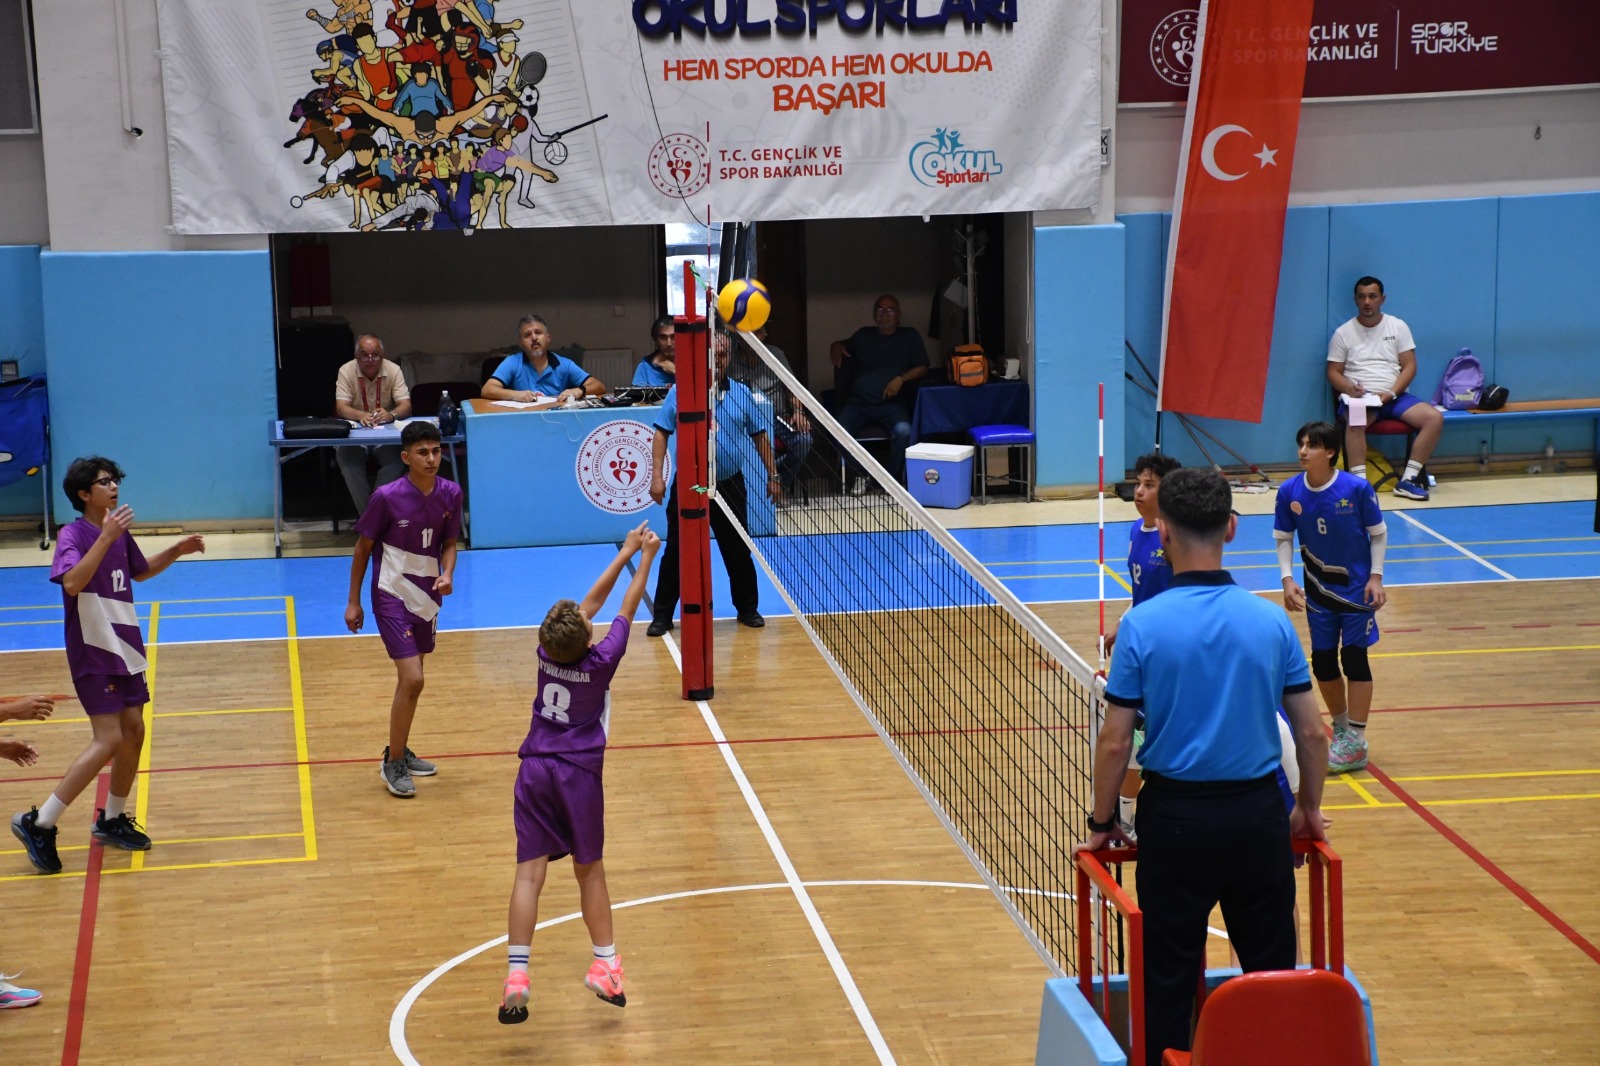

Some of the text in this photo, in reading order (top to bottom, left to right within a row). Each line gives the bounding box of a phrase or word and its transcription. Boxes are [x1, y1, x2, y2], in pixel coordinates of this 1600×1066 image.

[632, 0, 772, 37] OKUL
[1355, 23, 1379, 38] VE
[1411, 34, 1499, 55] TÜRKİYE
[663, 50, 994, 82] HEM SPORDA HEM OKULDA
[772, 81, 886, 116] BAŞARI
[719, 145, 842, 164] T.C. GENÇLİK VE
[921, 150, 1003, 178] OKUL
[719, 161, 843, 180] SPOR BAKANLIĞI
[936, 168, 990, 188] Sporları
[1316, 517, 1328, 535] 6
[421, 528, 434, 549] 11
[110, 569, 127, 593] 12
[1132, 563, 1142, 585] 12
[541, 682, 571, 724] 8
